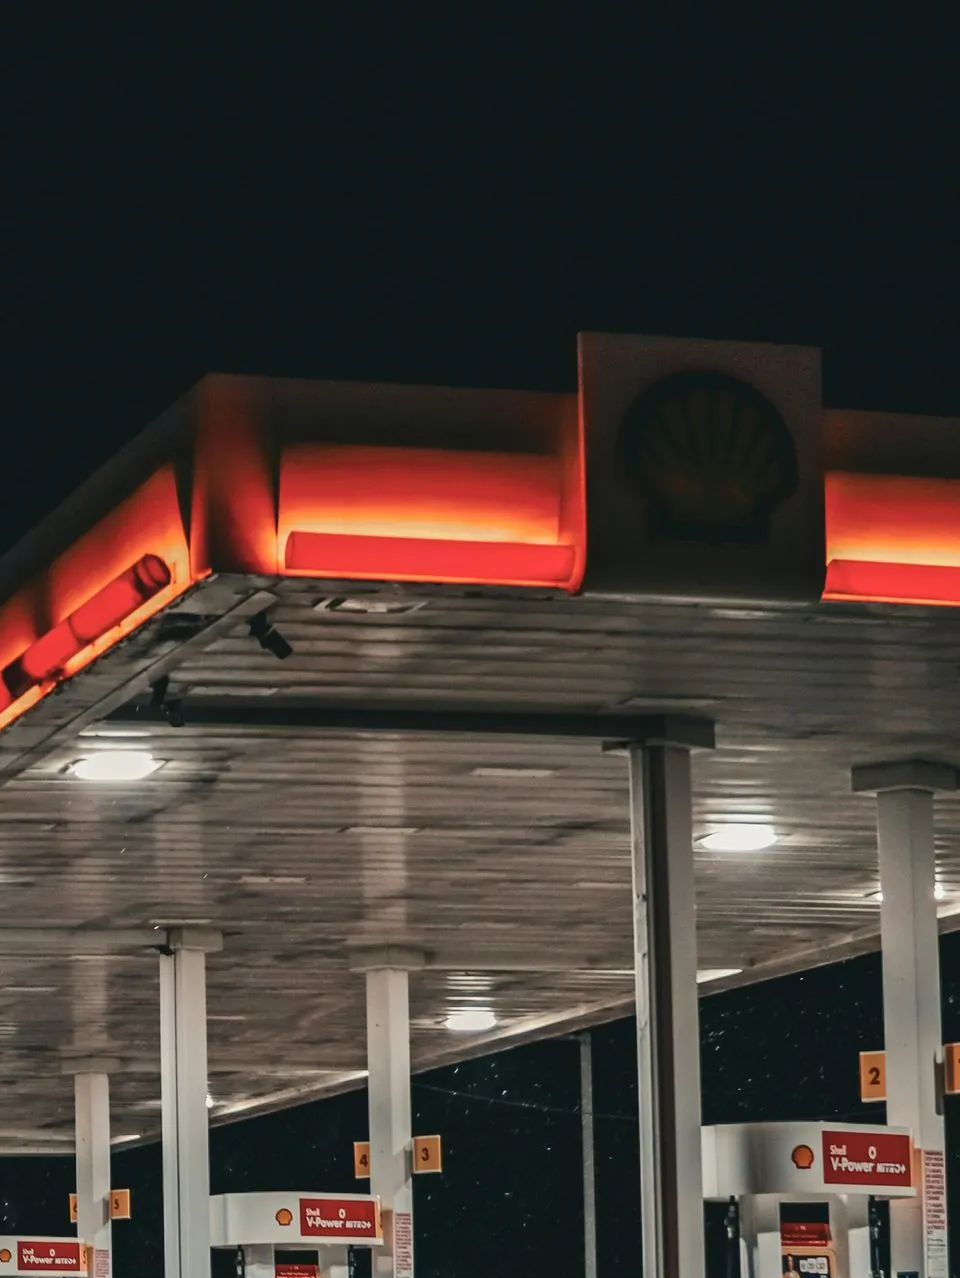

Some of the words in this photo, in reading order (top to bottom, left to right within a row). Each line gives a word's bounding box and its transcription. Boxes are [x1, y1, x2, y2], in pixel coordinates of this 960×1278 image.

[868, 1067, 881, 1085] 2
[421, 1147, 430, 1161] 3
[830, 1145, 847, 1156] Shell
[359, 1154, 369, 1167] 4
[831, 1157, 873, 1173] V-Power
[114, 1199, 120, 1210] 5
[305, 1208, 320, 1216] Shell
[306, 1216, 343, 1228] V-Power
[22, 1254, 54, 1264] V-Power
